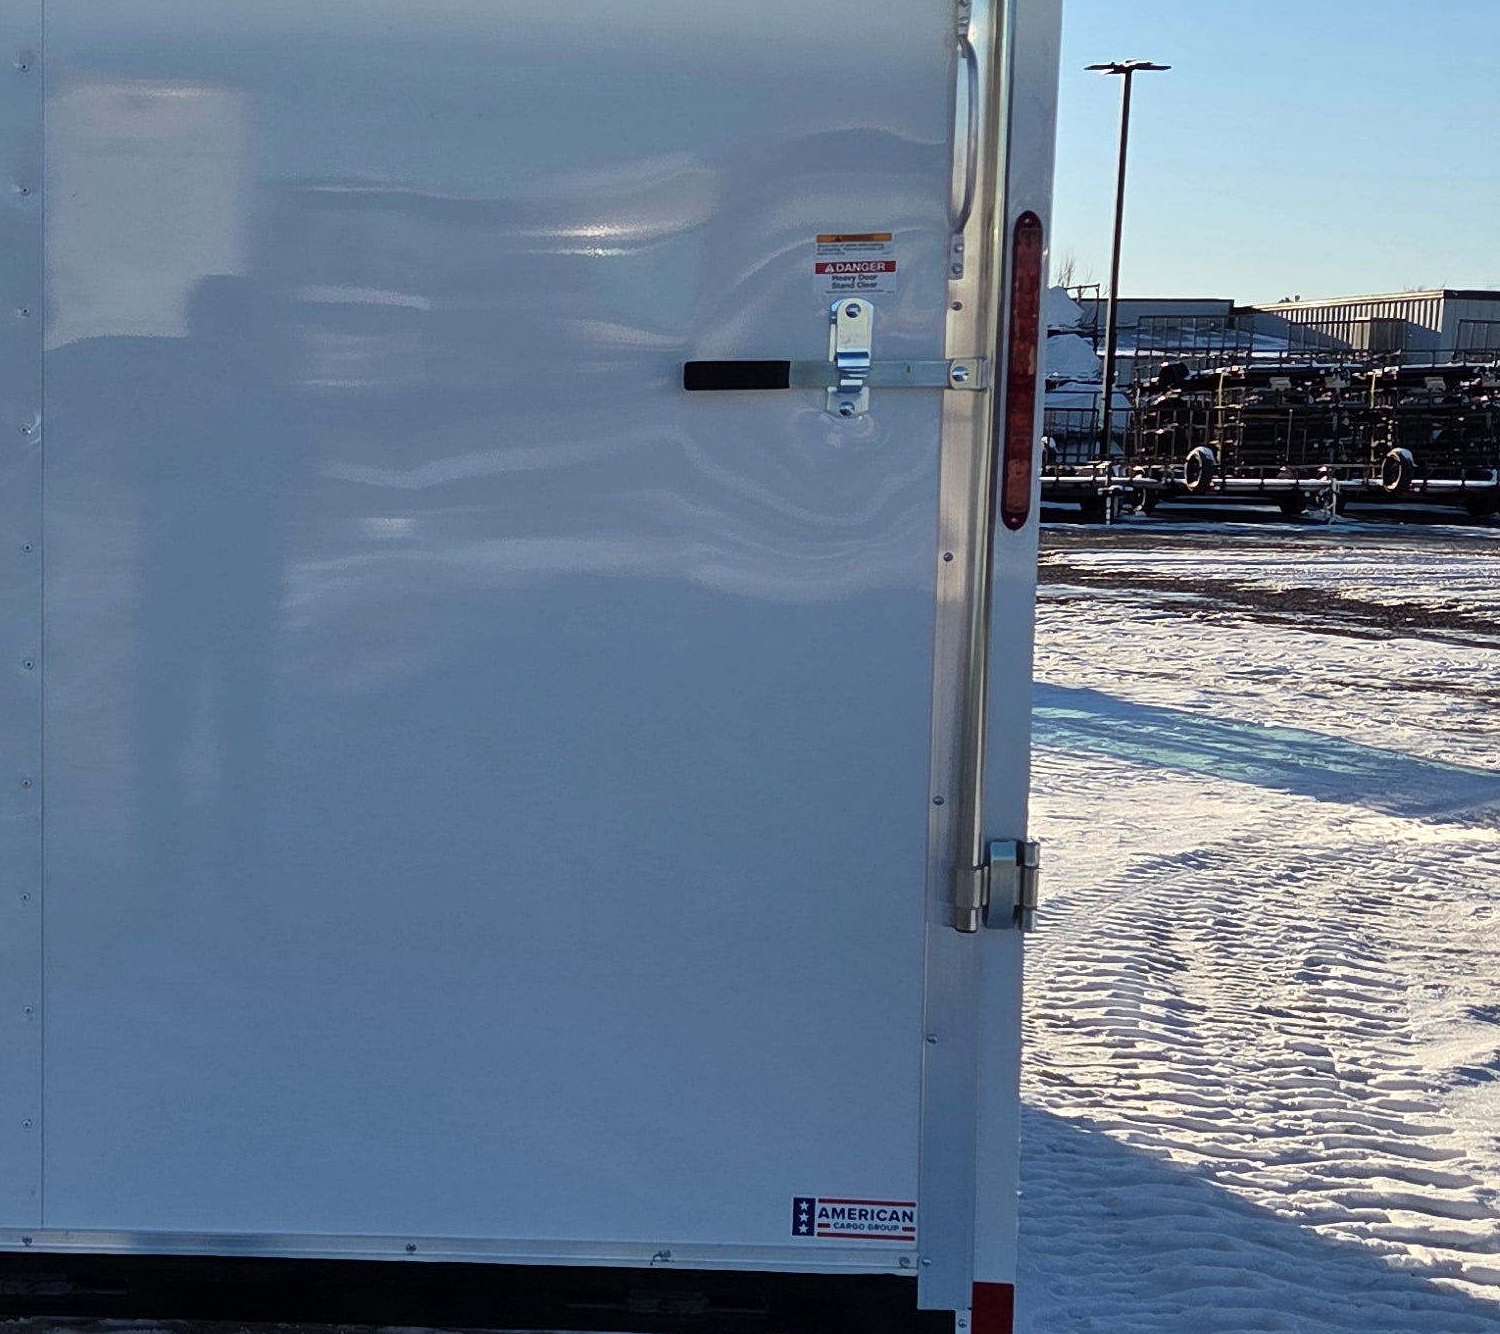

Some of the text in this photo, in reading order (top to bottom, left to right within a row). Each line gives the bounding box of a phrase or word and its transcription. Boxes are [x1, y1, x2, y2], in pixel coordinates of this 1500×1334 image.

[835, 262, 886, 273] DANGER
[831, 275, 857, 283] Heavy
[817, 1207, 914, 1223] AMERICAN
[833, 1222, 900, 1232] CARGO GROUP
